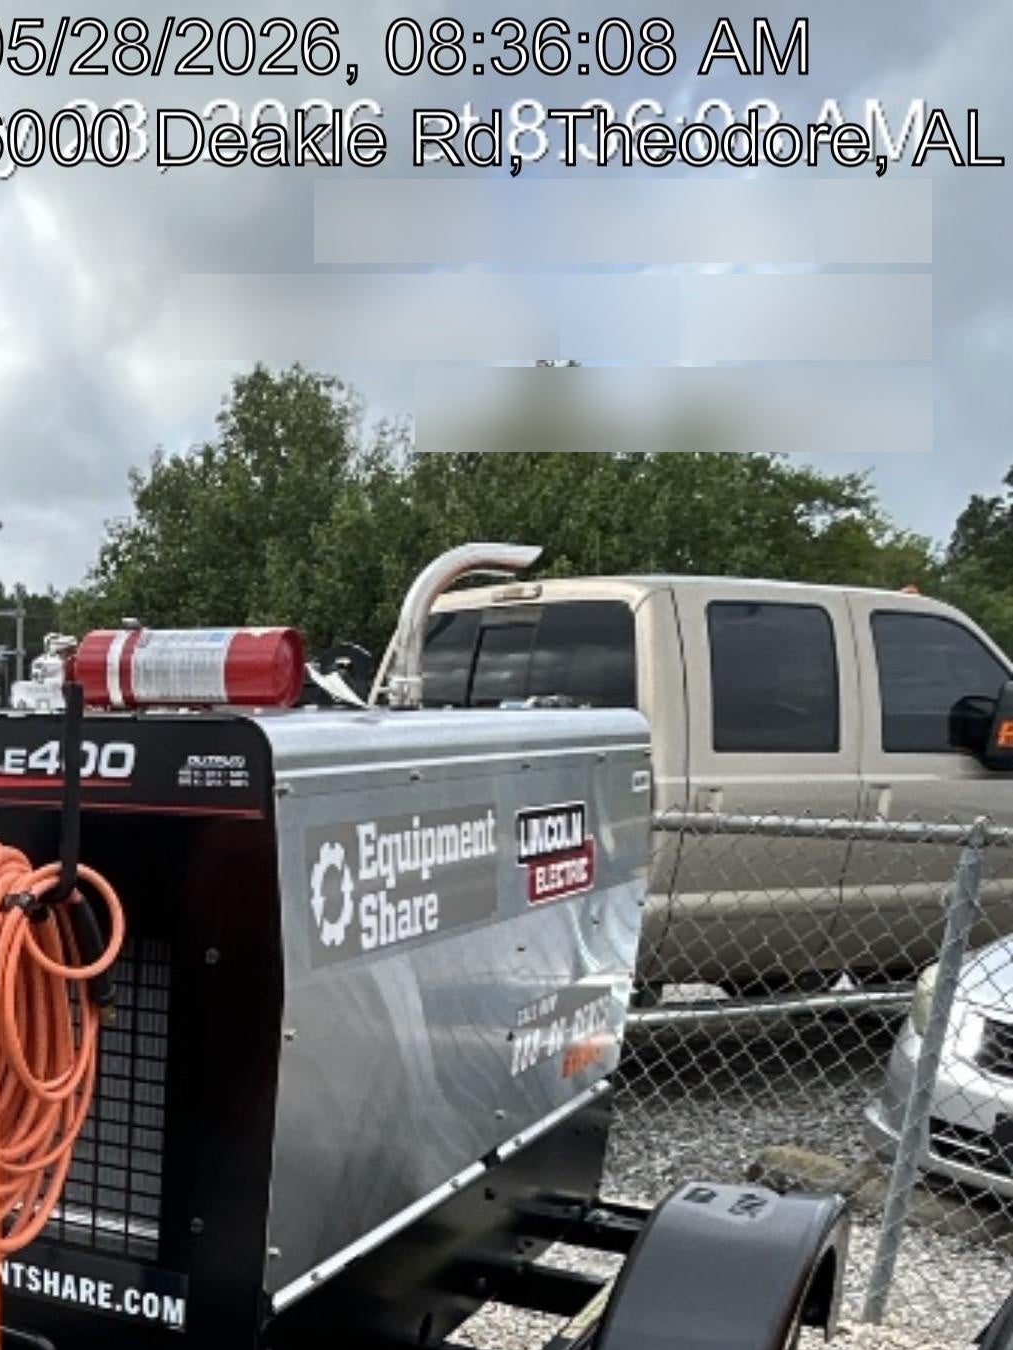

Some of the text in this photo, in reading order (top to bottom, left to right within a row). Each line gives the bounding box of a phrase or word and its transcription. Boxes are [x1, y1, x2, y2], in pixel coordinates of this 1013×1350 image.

[356, 809, 496, 889] Equipment
[520, 811, 583, 857] LINCOLN
[359, 890, 439, 950] Share
